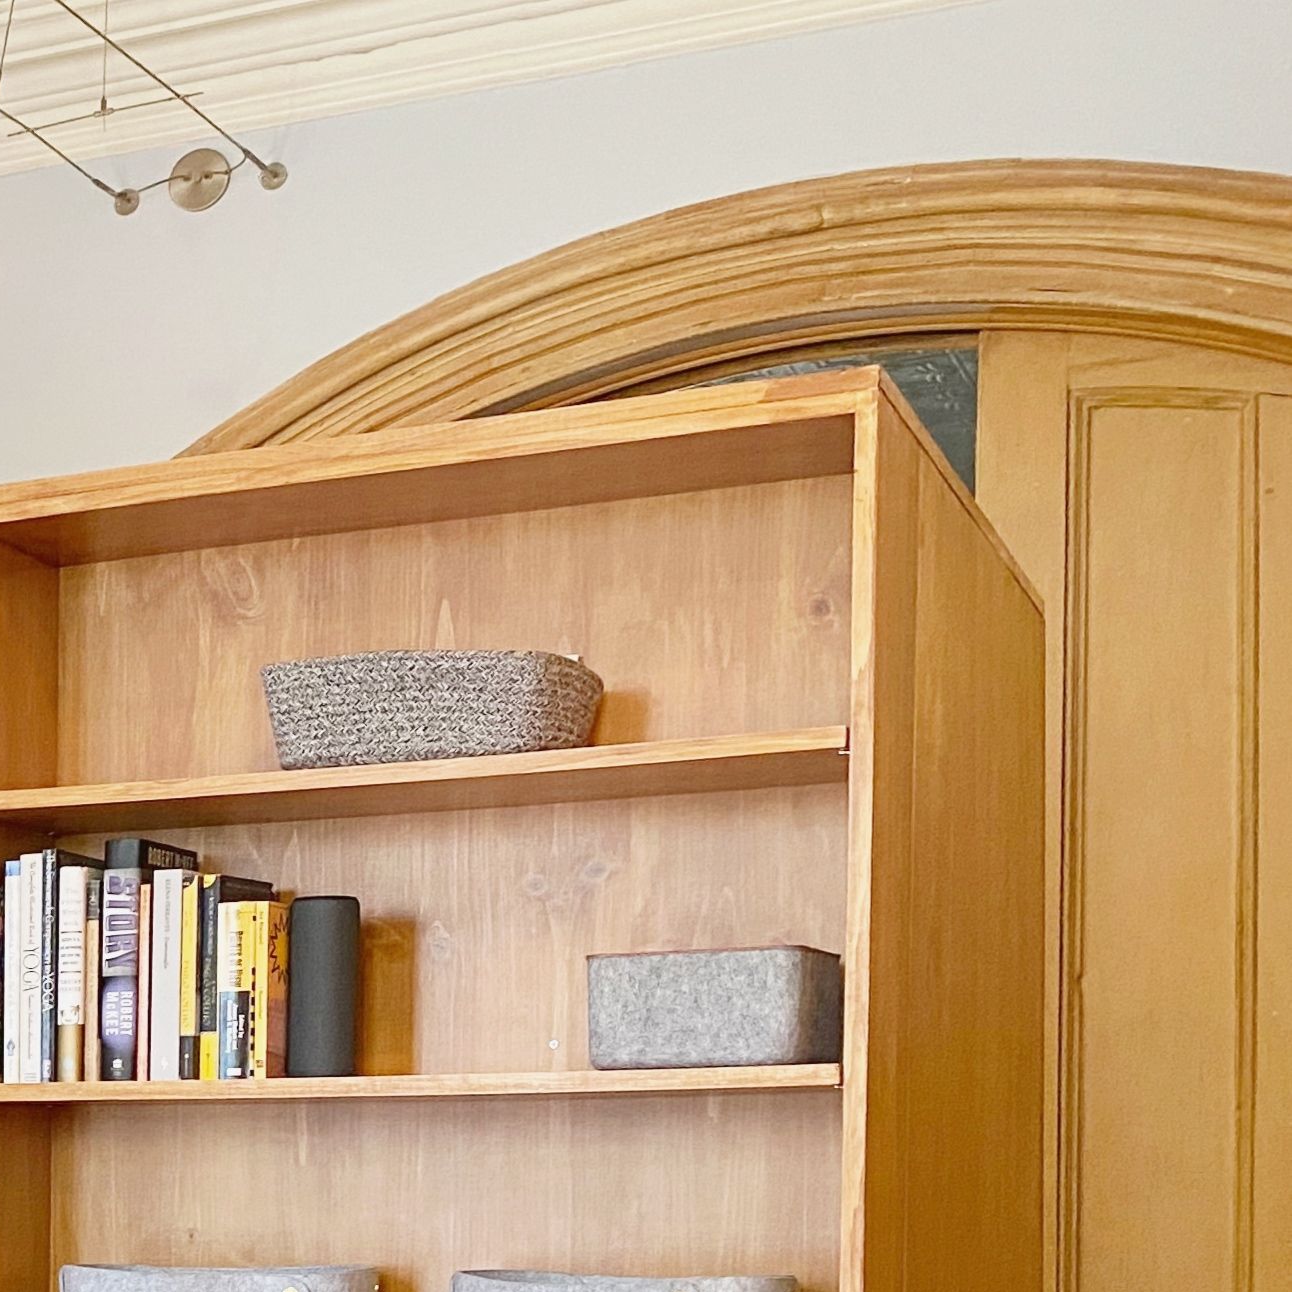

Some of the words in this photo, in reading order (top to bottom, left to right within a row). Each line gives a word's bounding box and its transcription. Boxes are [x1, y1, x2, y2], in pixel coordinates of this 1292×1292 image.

[105, 875, 139, 969] STORY
[22, 946, 41, 992] YOGA
[42, 972, 54, 1012] YOGA
[105, 991, 120, 1036] McKEE
[120, 991, 134, 1036] ROBERT
